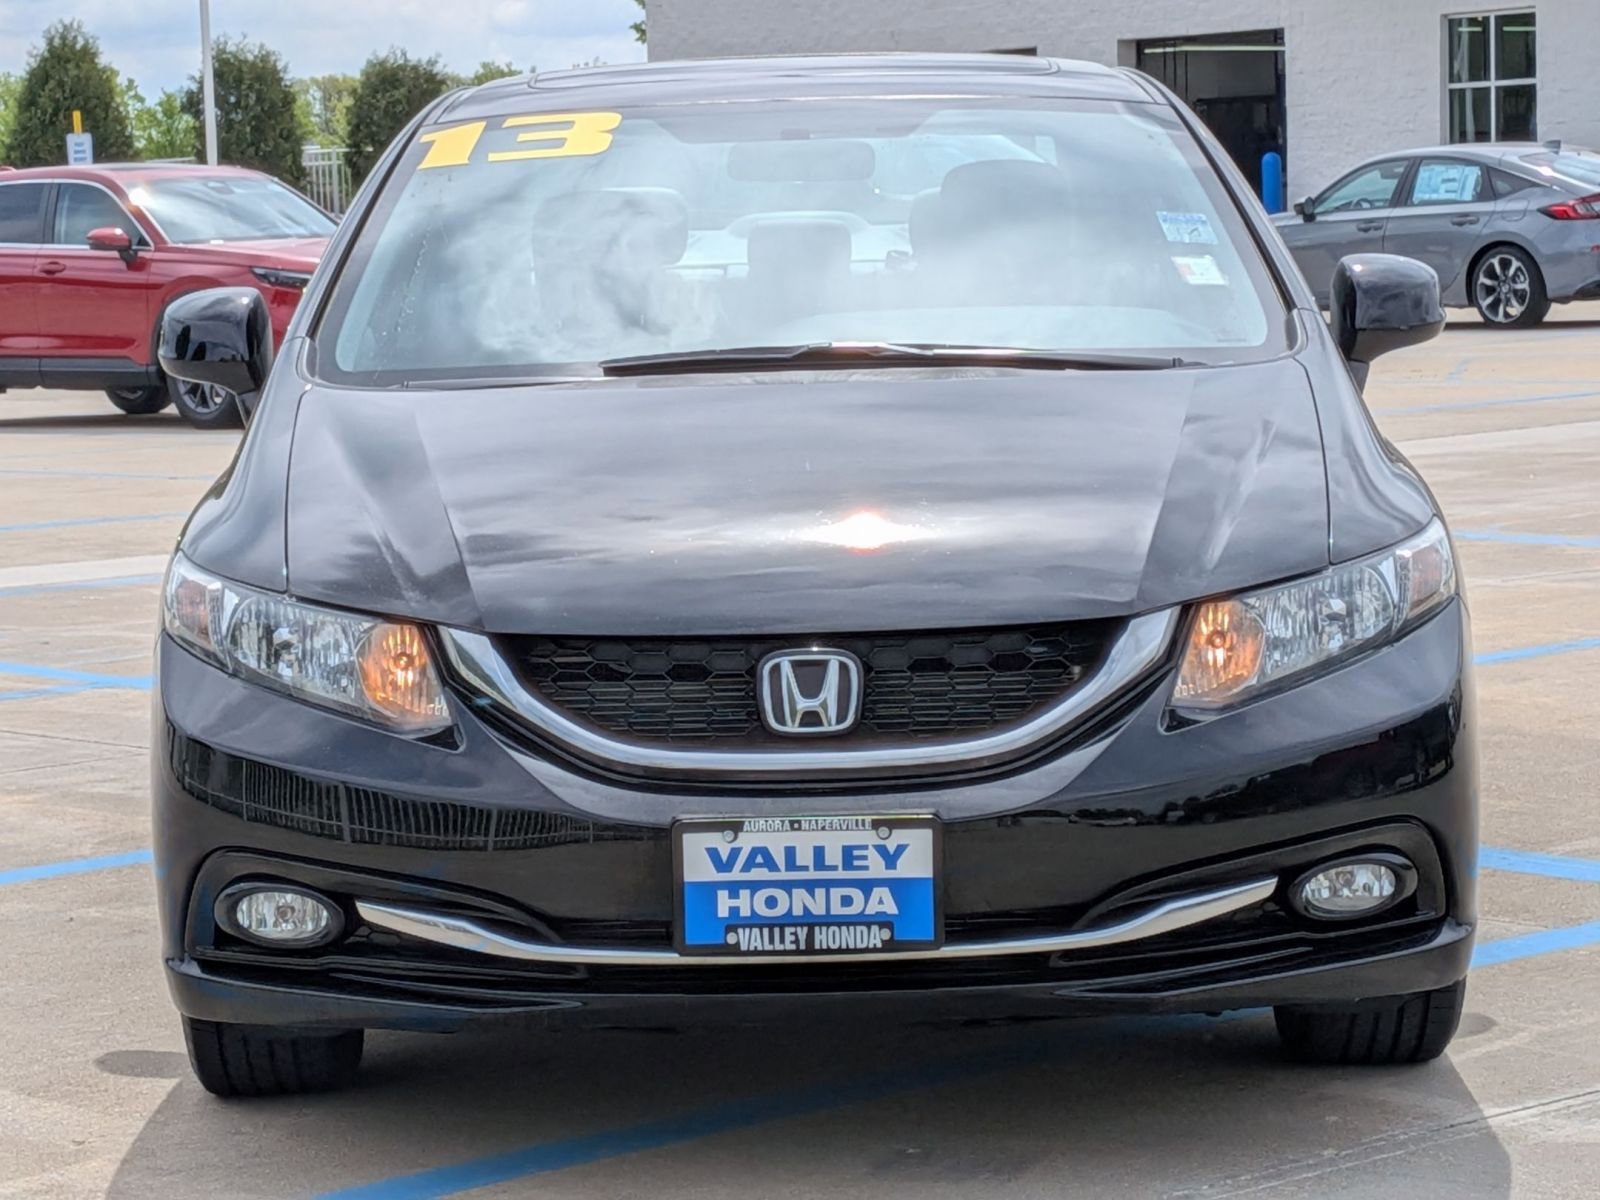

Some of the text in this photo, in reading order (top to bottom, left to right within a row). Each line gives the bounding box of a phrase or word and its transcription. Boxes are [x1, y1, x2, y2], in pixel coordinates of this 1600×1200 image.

[417, 112, 623, 170] 13
[743, 818, 872, 832] AURORA NAPERVILLE
[704, 843, 910, 874] VALLEY
[717, 887, 899, 918] HONDA
[737, 924, 882, 951] VALLEY HONDA
